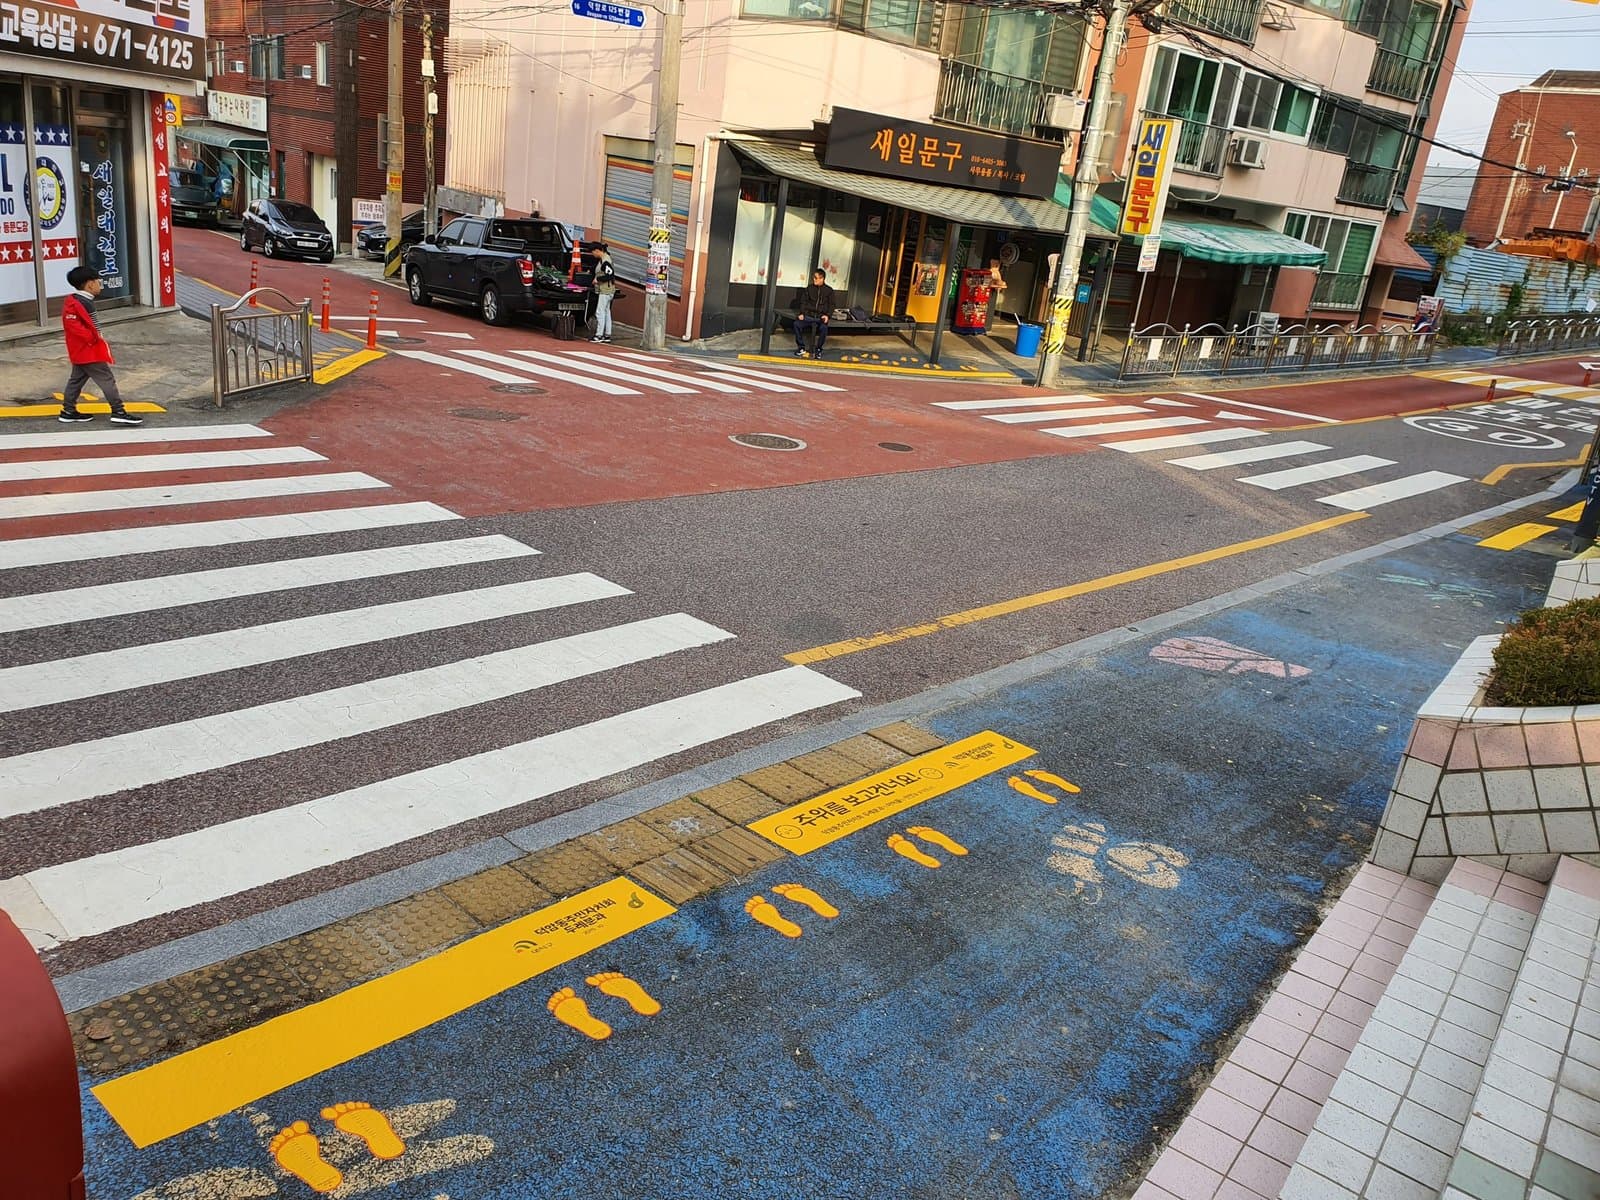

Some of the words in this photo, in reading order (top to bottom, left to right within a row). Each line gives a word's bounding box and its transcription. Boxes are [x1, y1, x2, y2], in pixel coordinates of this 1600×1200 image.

[94, 23, 194, 71] 671-4125
[870, 128, 963, 171] 새일문구
[1126, 123, 1166, 232] 새일문구
[1427, 420, 1538, 444] 30
[792, 801, 851, 827] 주위를
[841, 771, 922, 807] 보고건너요!
[533, 898, 617, 936] 덕암동주민자치회
[563, 912, 608, 934] 두레분과
